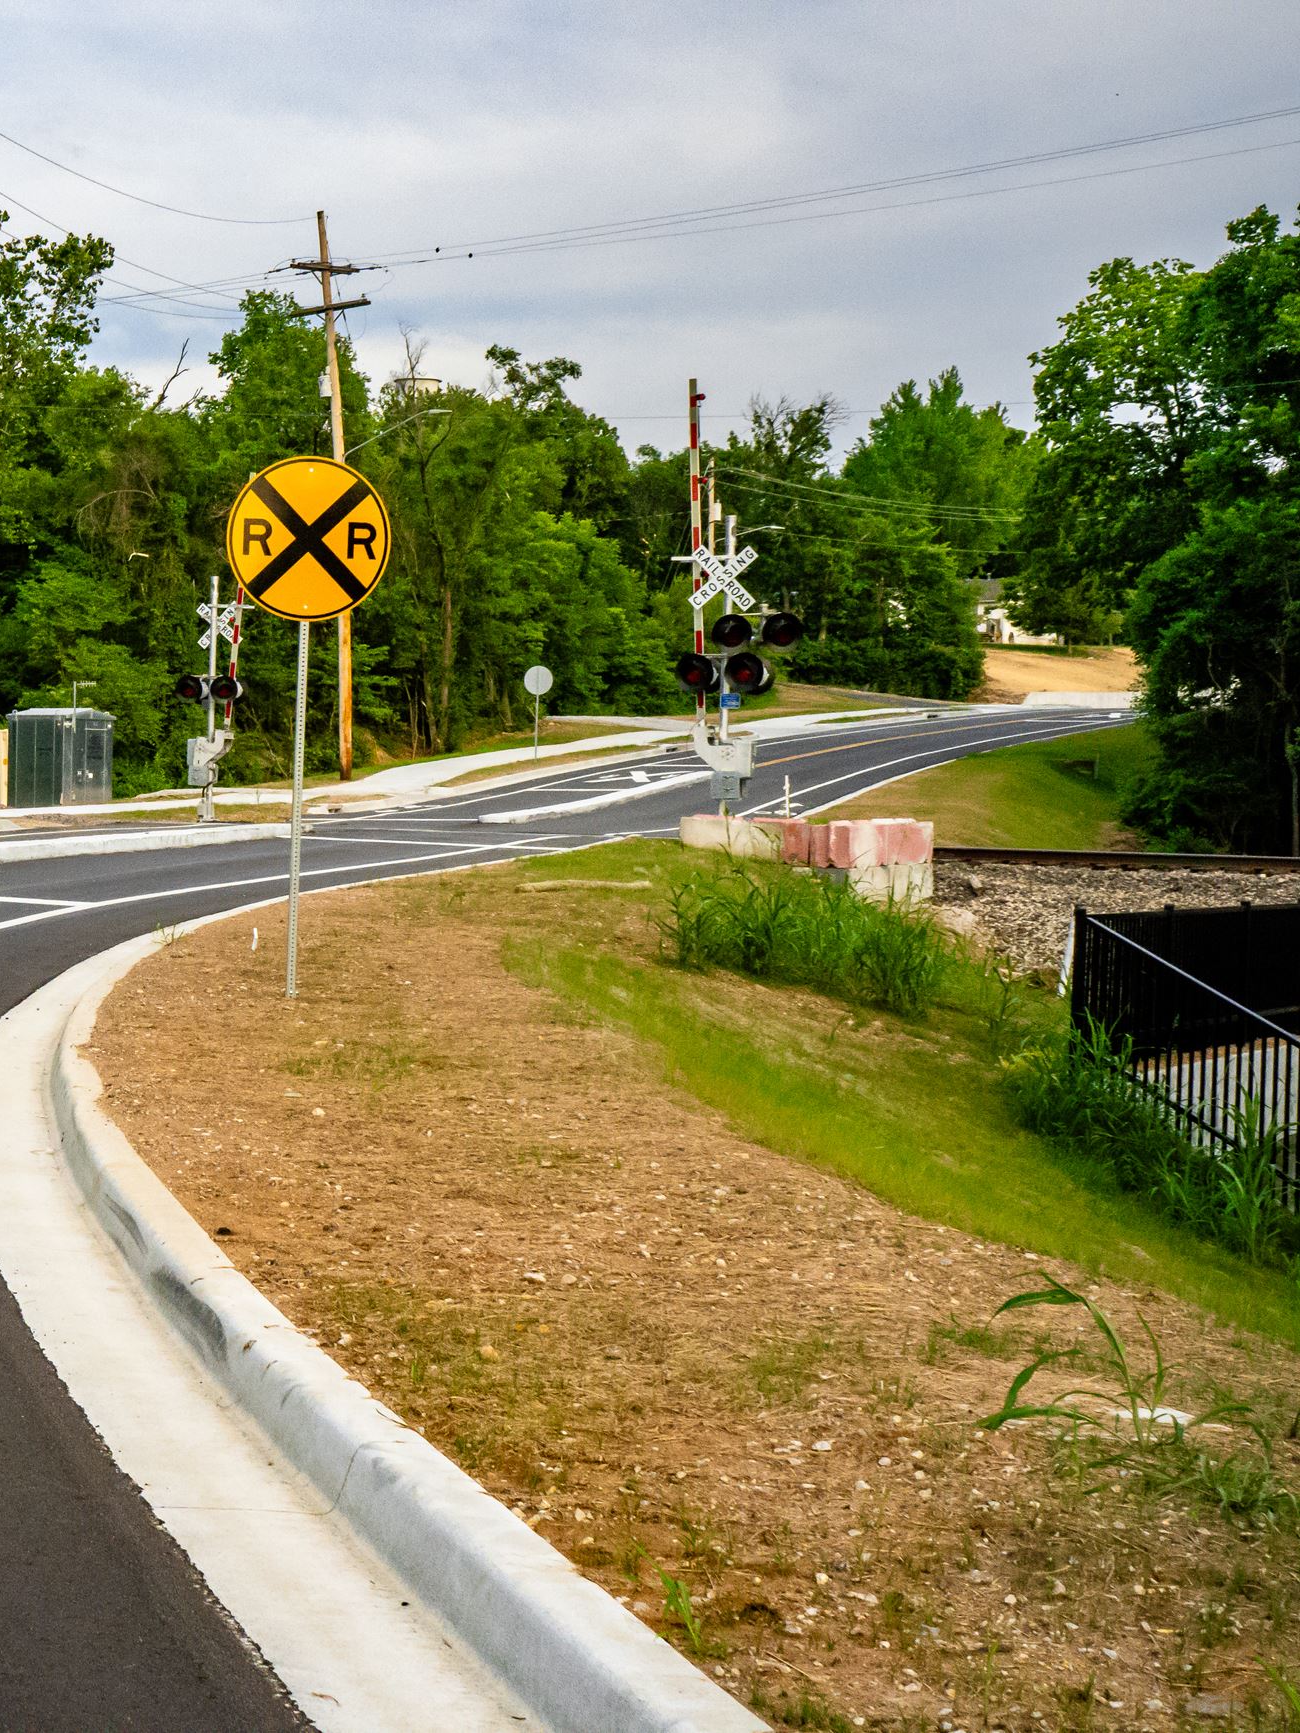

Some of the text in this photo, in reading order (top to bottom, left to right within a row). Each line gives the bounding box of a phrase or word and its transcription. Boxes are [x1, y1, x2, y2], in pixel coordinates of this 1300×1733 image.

[242, 518, 377, 560] R R
[692, 549, 754, 606] CROSSING
